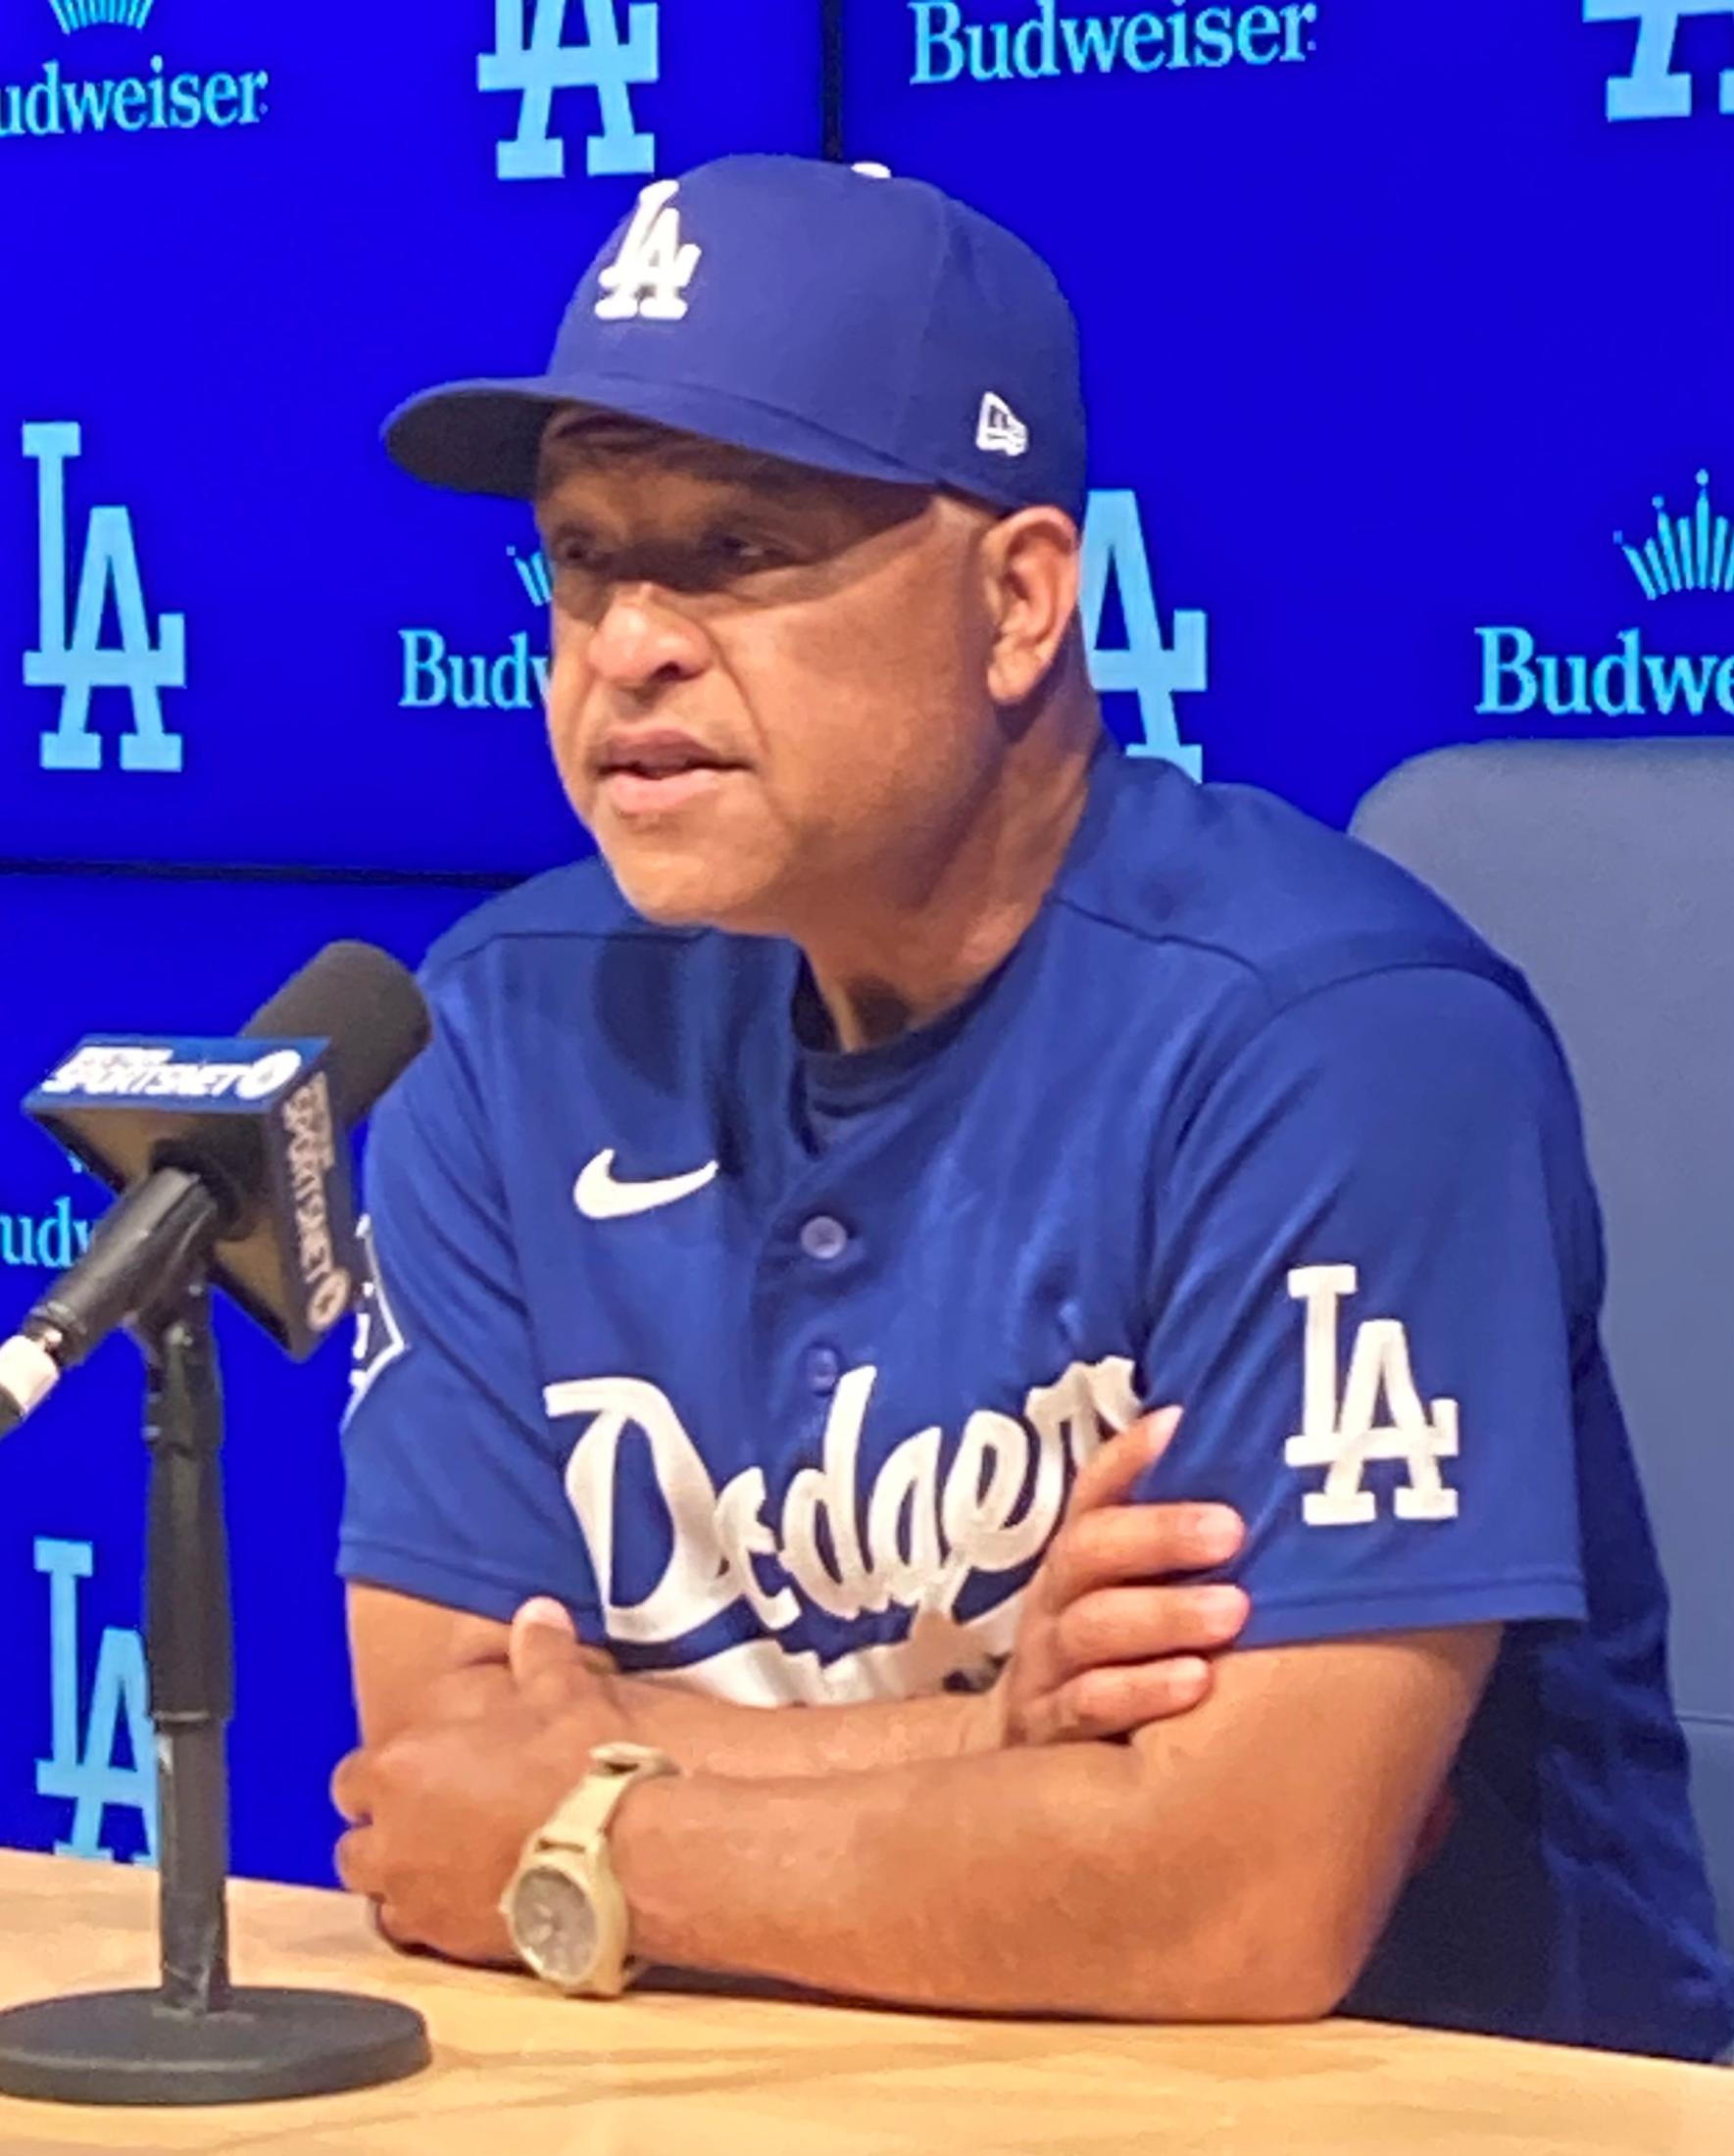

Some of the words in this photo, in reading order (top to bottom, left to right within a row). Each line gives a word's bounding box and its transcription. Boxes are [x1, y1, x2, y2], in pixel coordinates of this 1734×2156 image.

[909, 0, 1316, 84] Budweiser
[0, 55, 268, 136] udweiser
[595, 179, 702, 320] LA
[22, 421, 185, 772] LA
[398, 628, 552, 710] Bud
[1474, 626, 1734, 715] Budw
[1284, 1264, 1459, 1526] LA
